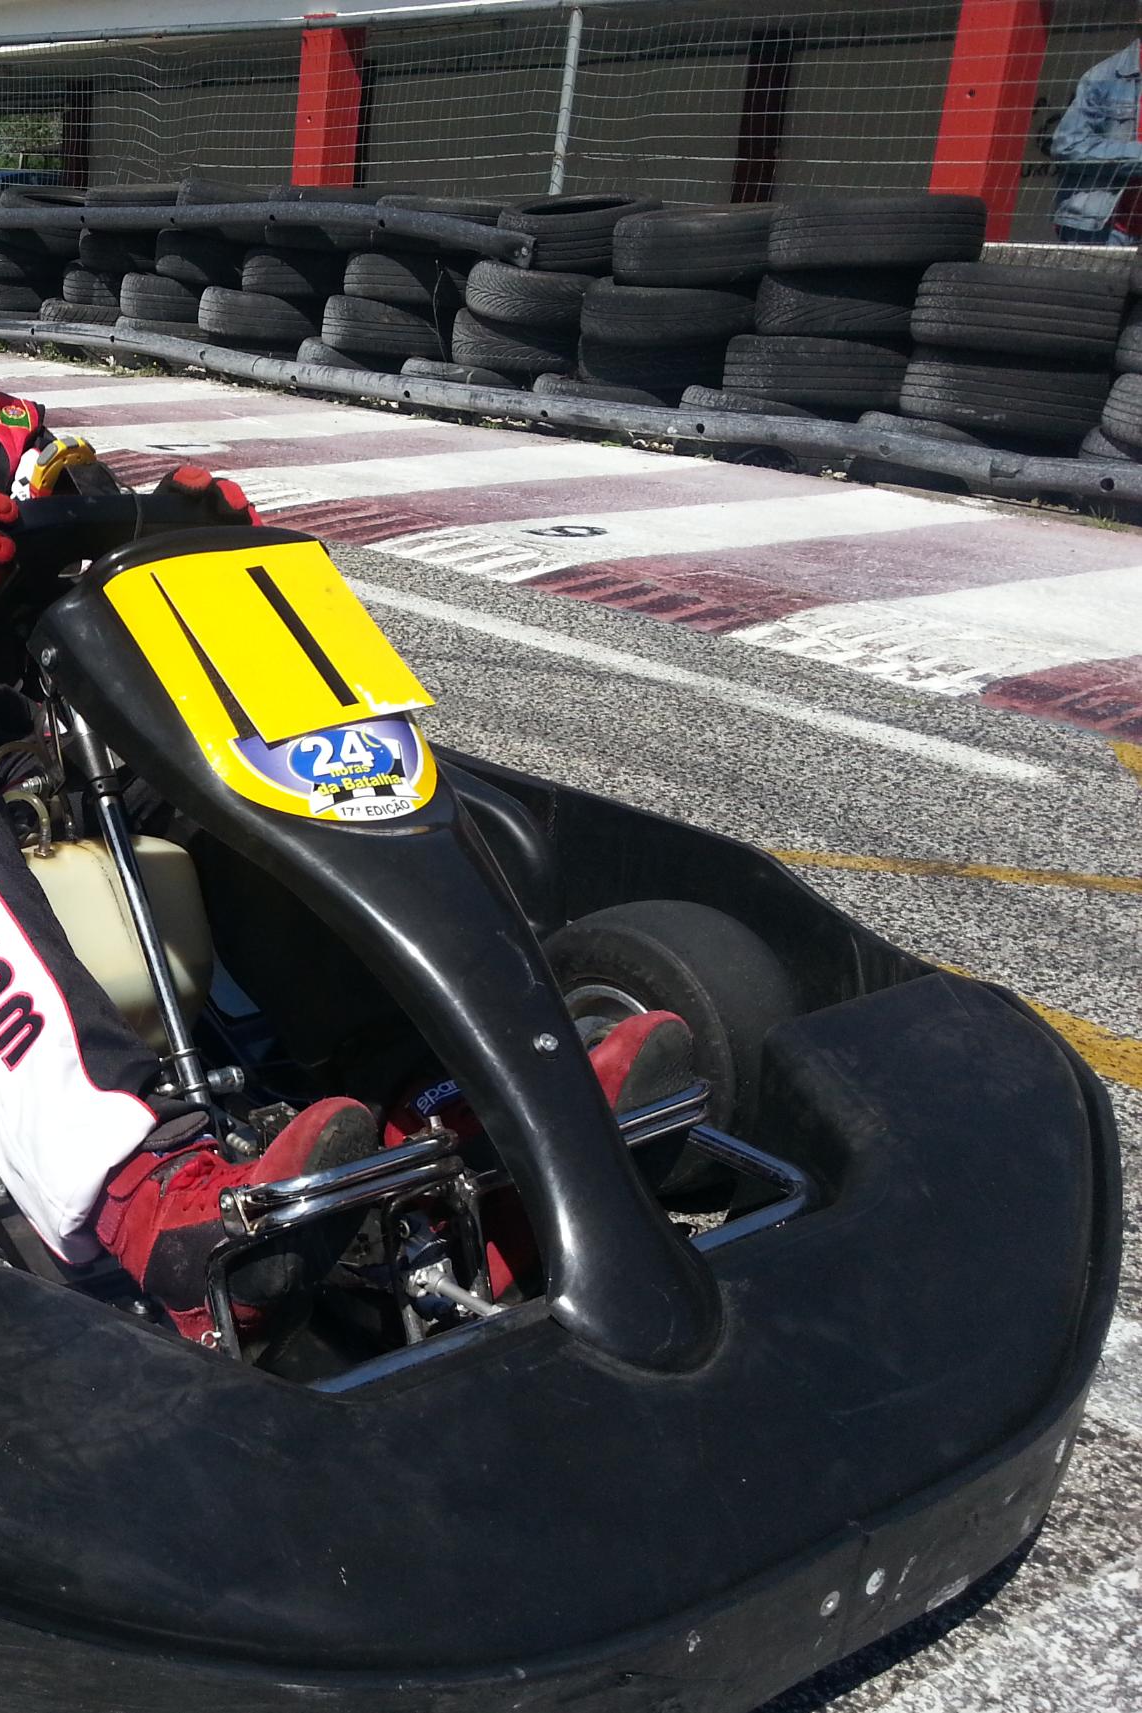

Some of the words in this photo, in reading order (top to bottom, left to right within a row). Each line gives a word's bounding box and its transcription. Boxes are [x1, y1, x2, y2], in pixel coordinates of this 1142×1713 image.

[300, 731, 375, 777] 24
[317, 782, 341, 797] da
[340, 772, 402, 792] Batalha
[365, 799, 411, 818] EDIÇÃO
